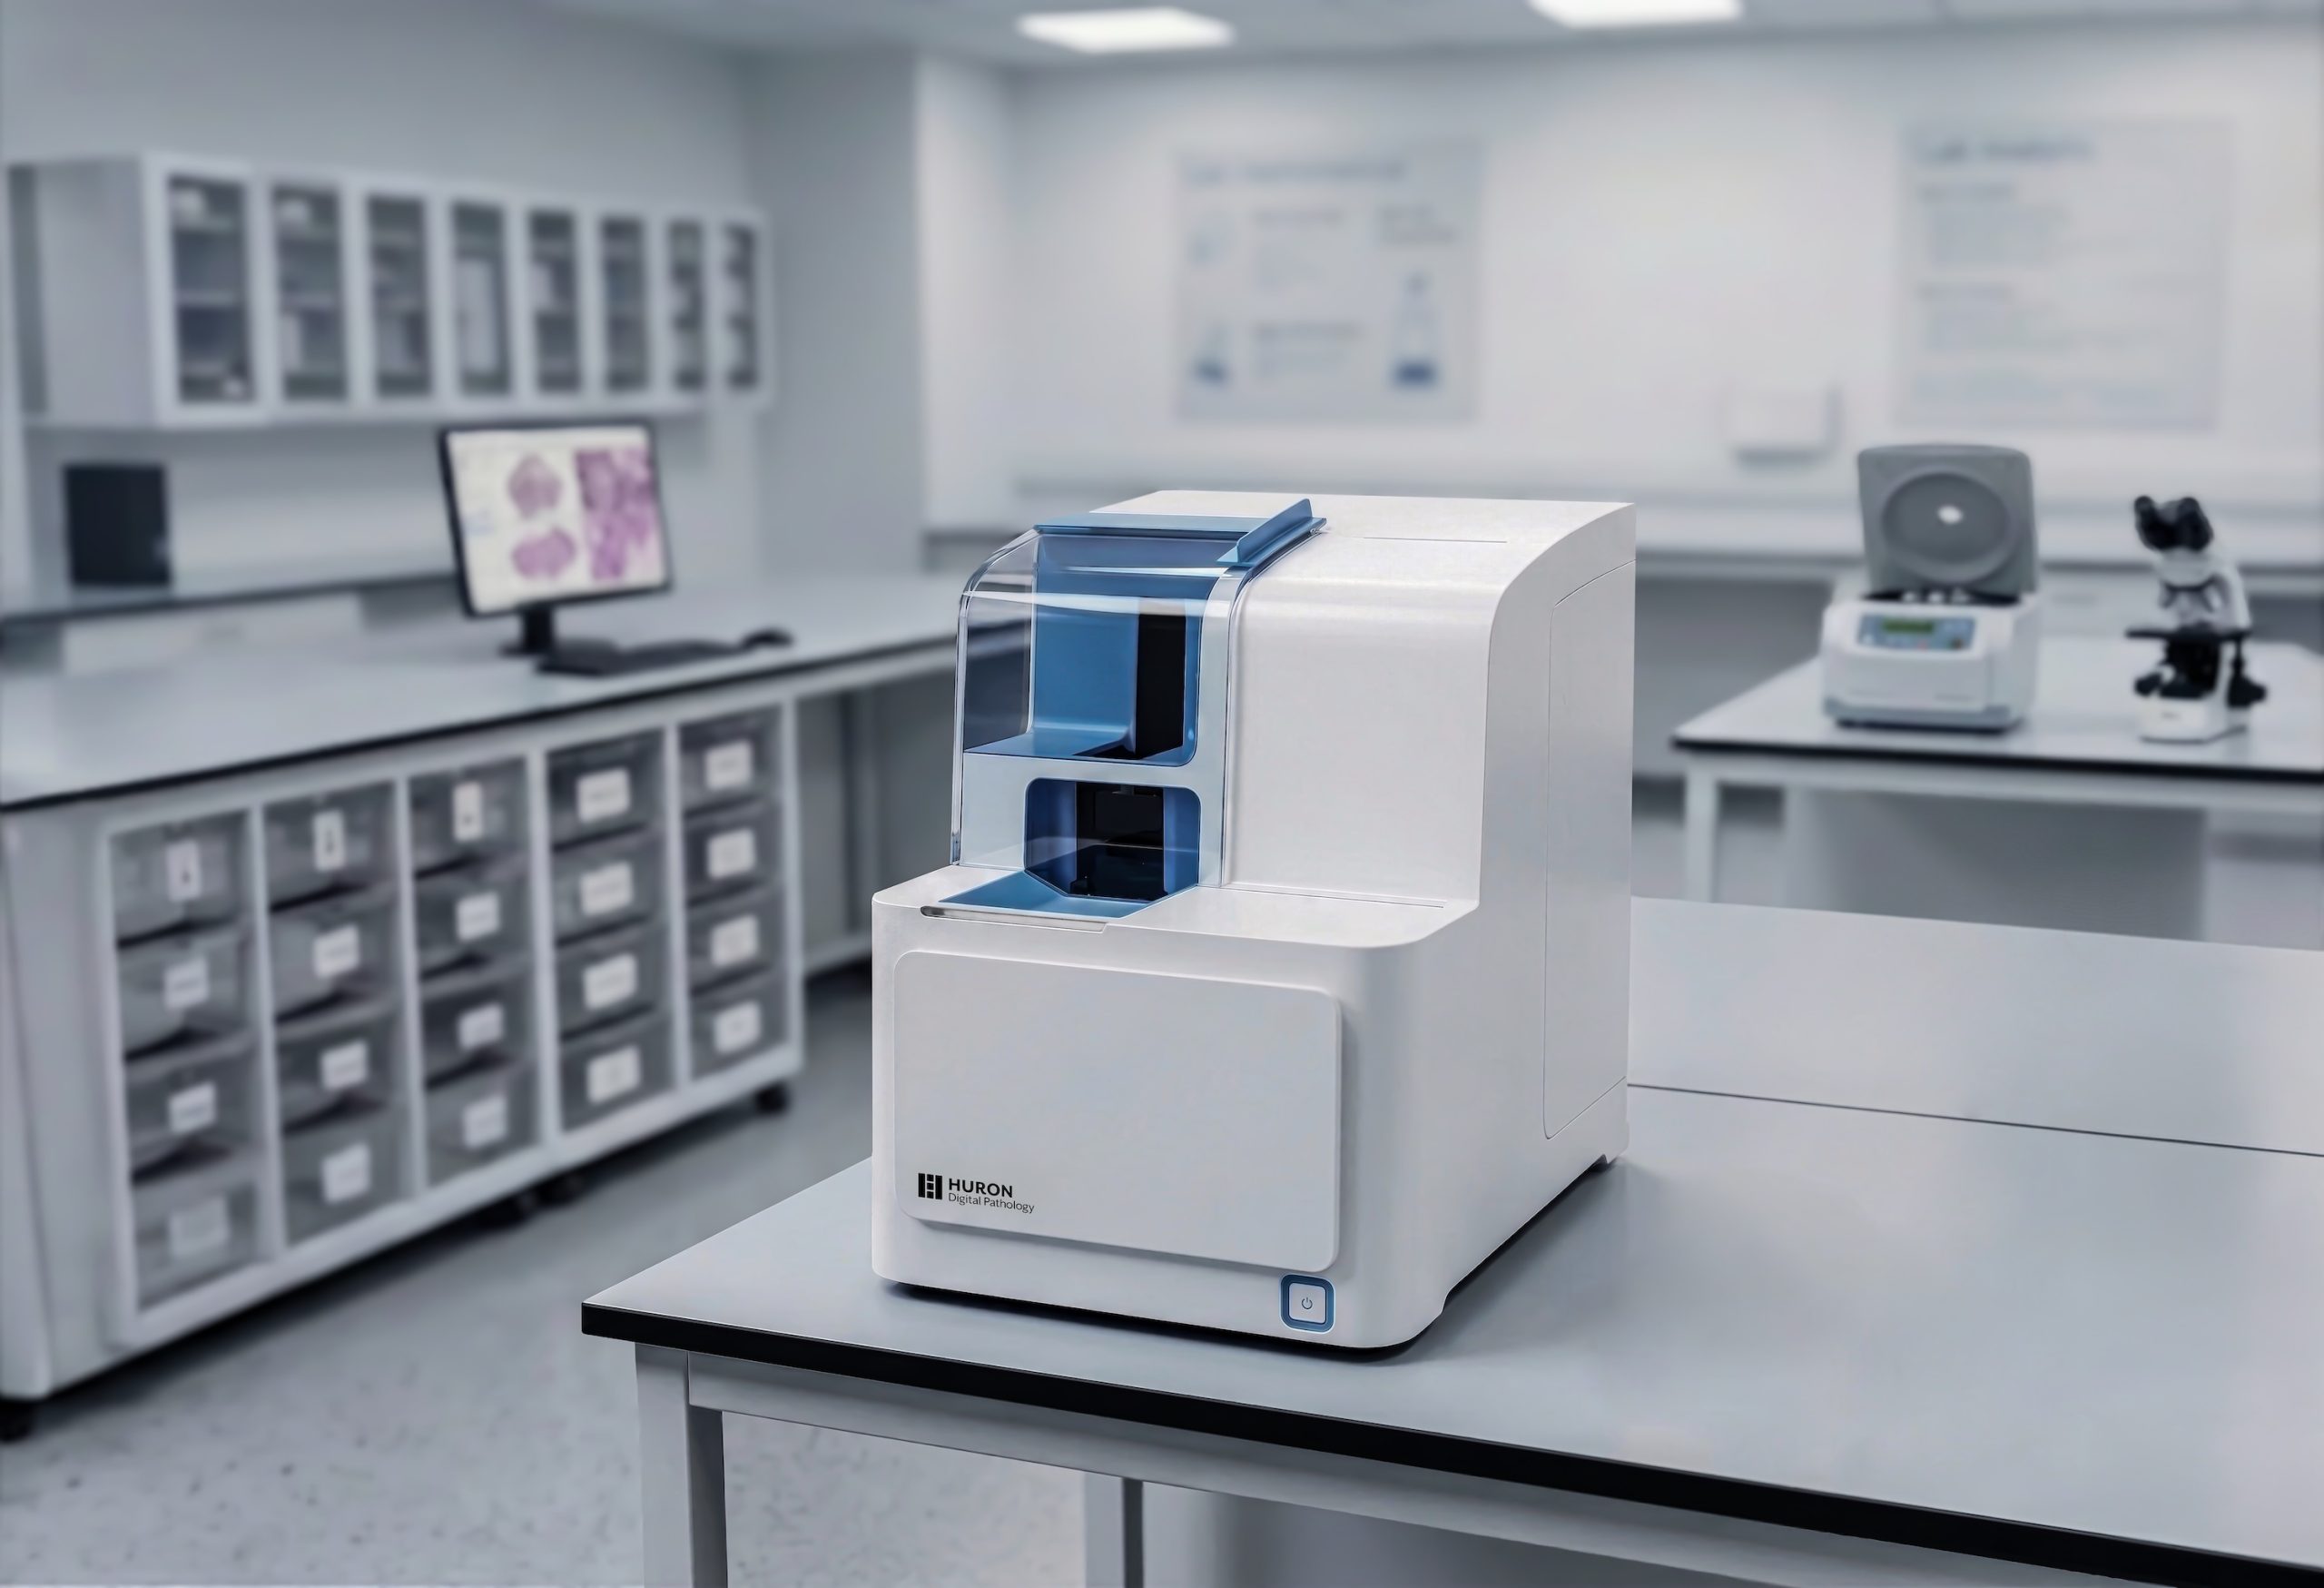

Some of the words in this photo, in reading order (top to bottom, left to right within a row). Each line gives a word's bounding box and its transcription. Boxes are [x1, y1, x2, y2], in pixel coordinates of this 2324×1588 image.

[949, 1178, 1012, 1198] HURON
[949, 1192, 981, 1206] Digital
[984, 1197, 1035, 1214] Pathology
